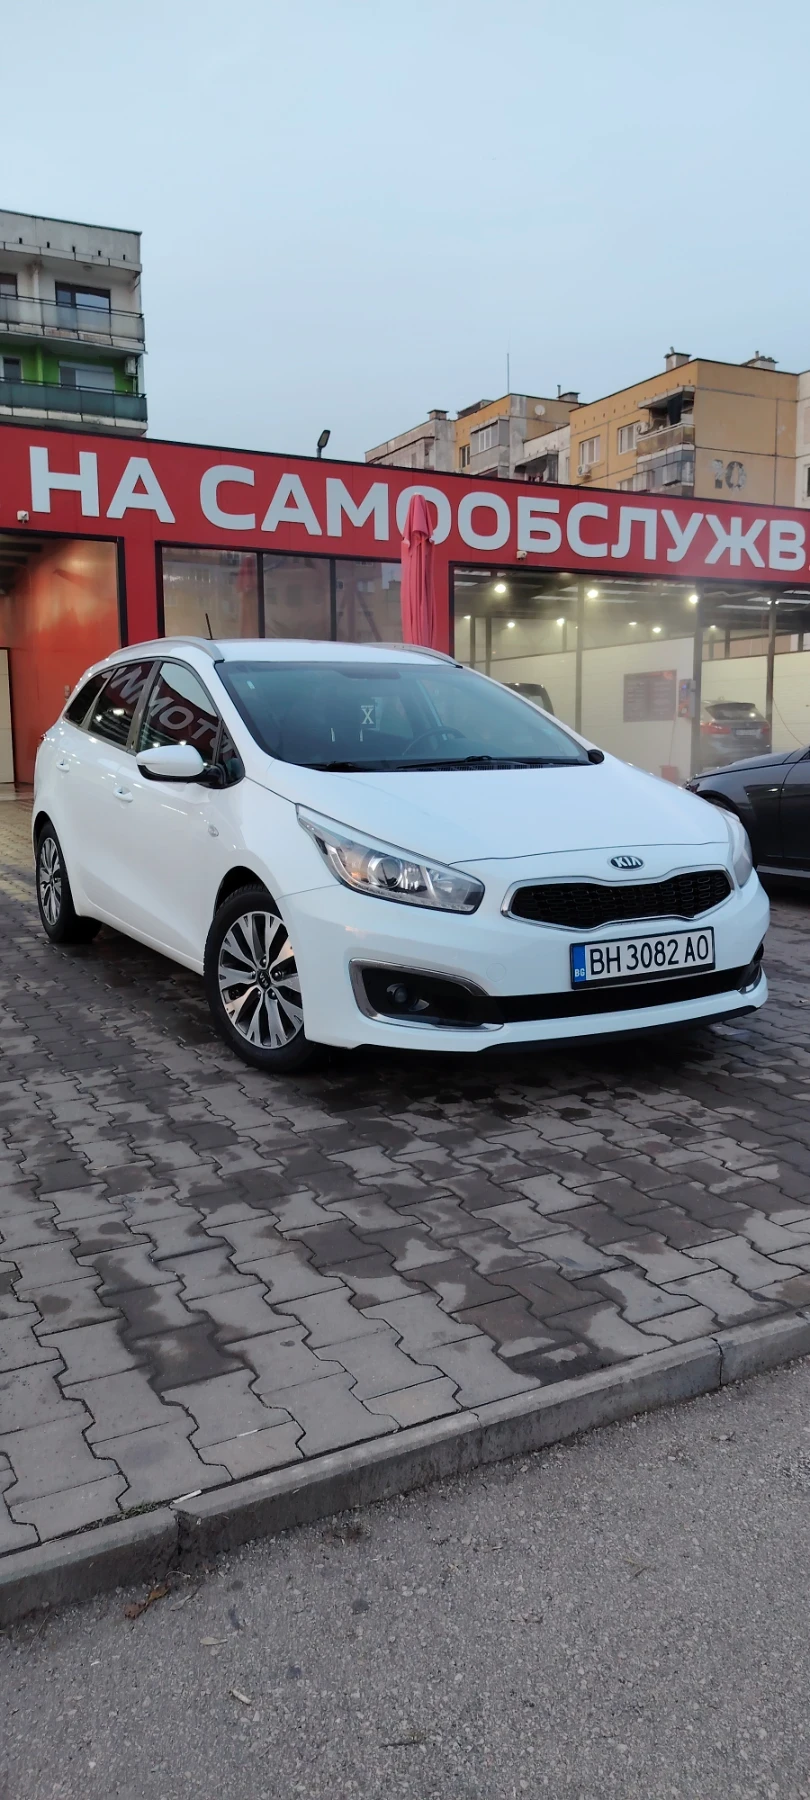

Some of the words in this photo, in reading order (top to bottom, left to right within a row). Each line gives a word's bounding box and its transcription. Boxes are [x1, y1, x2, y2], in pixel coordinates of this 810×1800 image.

[29, 446, 176, 524] НА
[199, 464, 810, 572] САМООБСЛУЖВ
[613, 856, 642, 867] KIA
[626, 939, 679, 970] 3082
[574, 968, 586, 978] BG
